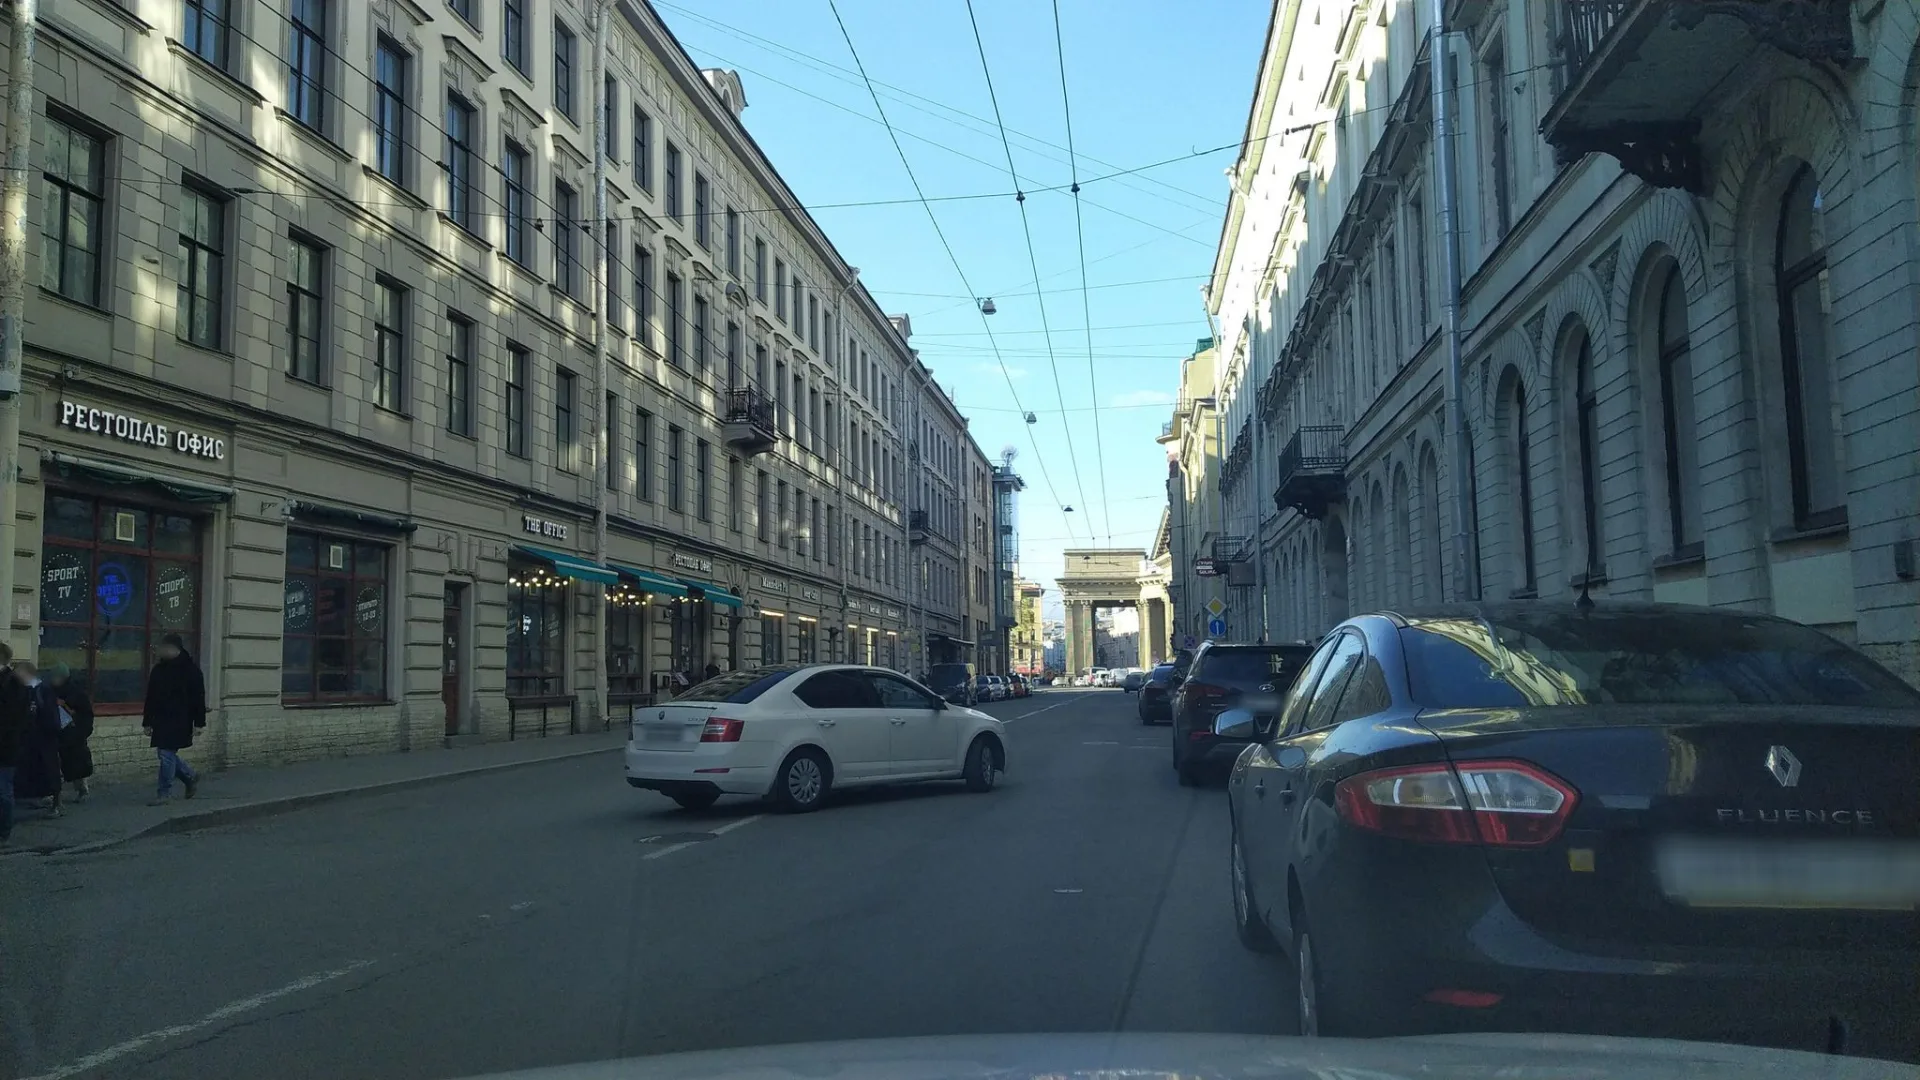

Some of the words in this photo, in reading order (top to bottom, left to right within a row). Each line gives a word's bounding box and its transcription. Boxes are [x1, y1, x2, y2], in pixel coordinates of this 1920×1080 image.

[61, 400, 168, 447] РЕСТОПАБ
[176, 430, 225, 460] ОФИС
[525, 516, 541, 533] THE
[543, 521, 568, 539] OFFICE
[47, 566, 79, 582] SPORT
[58, 585, 71, 599] TV
[97, 583, 127, 596] OFFICE
[159, 577, 185, 594] СПОРТ
[169, 596, 180, 608] ТВ
[1716, 808, 1874, 824] FLUENCE
